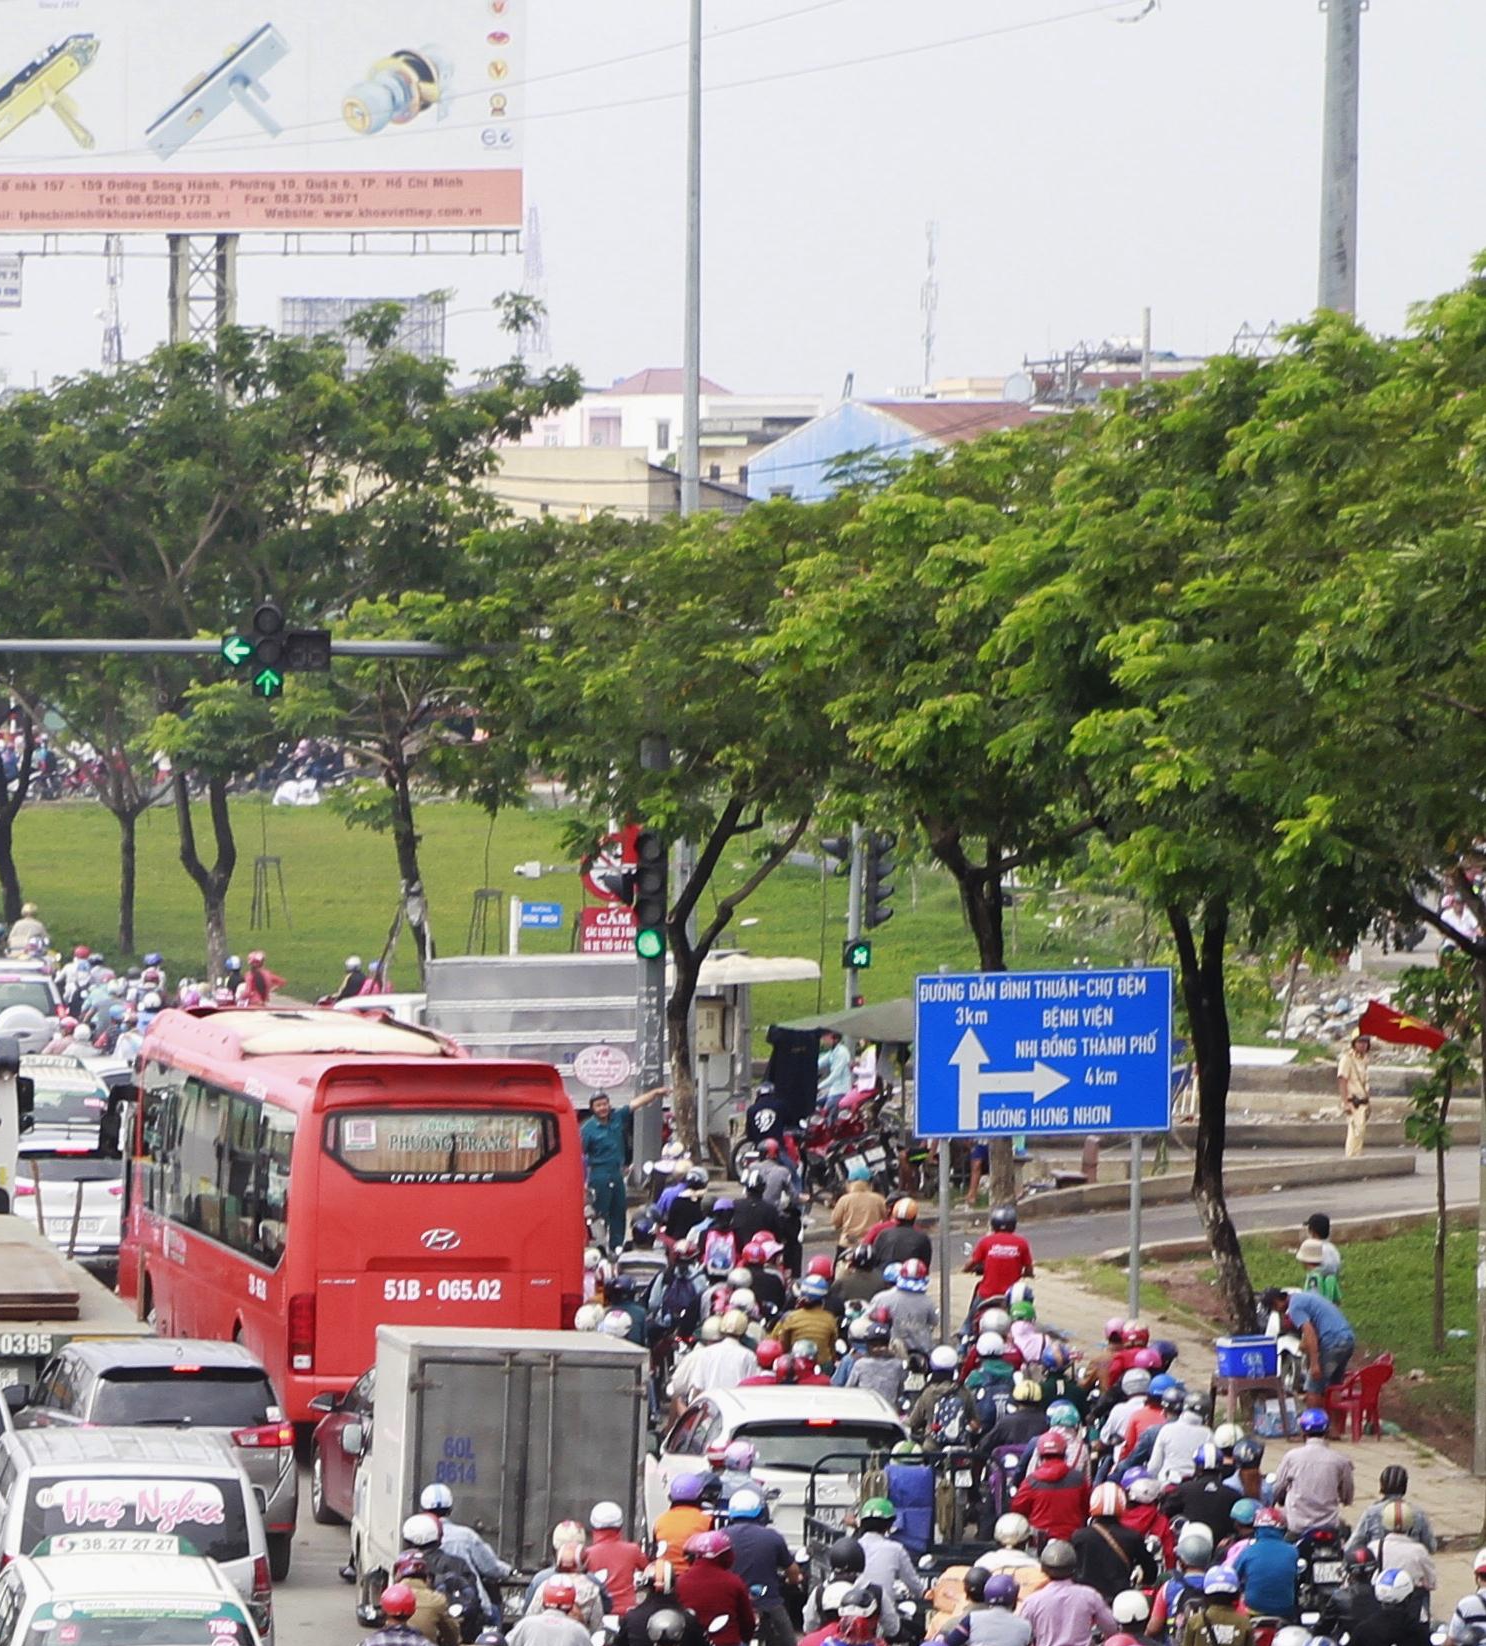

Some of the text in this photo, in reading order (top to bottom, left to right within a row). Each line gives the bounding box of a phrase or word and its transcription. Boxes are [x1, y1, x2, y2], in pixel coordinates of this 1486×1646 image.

[919, 979, 965, 1003] ĐƯỜNG
[969, 975, 996, 1002] DẪN
[999, 978, 1031, 1001] BÌNH
[1117, 975, 1147, 999] ĐỆM
[955, 1006, 989, 1026] 3km
[1042, 1005, 1114, 1030] BỆNH VIỆN
[1015, 1028, 1159, 1059] NHI ĐỒNG THÀNH PHỐ
[981, 1103, 1027, 1129] ĐƯỜNG
[1073, 1104, 1111, 1126] NHƠN
[383, 1279, 422, 1301] 51B
[437, 1279, 503, 1302] 065.02
[444, 1437, 476, 1460] 60L
